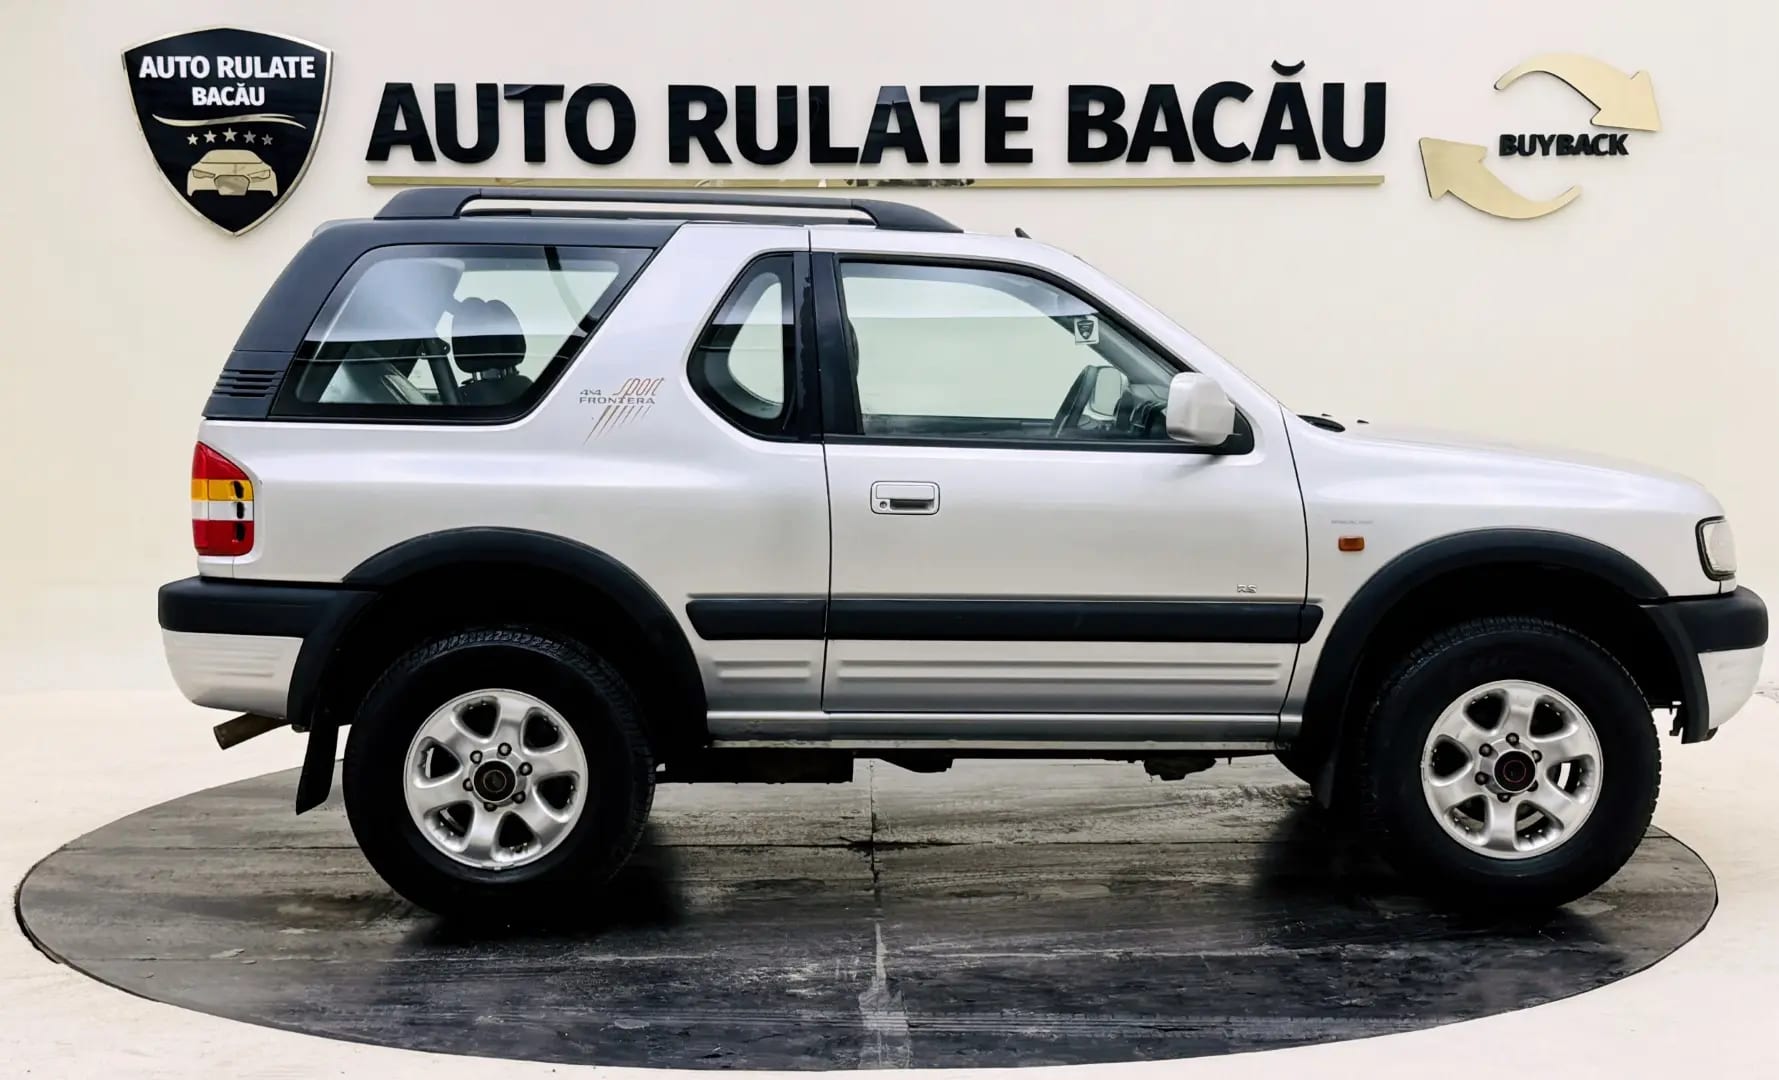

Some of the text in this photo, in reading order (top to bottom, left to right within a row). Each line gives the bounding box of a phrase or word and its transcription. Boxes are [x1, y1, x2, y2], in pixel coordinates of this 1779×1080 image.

[139, 55, 315, 79] AUTO RULATE
[191, 83, 265, 107] BACĂU
[365, 60, 1388, 165] AUTO RULATE BACĂU
[1499, 133, 1629, 157] BUYBACK
[579, 396, 655, 405] FRONTERA
